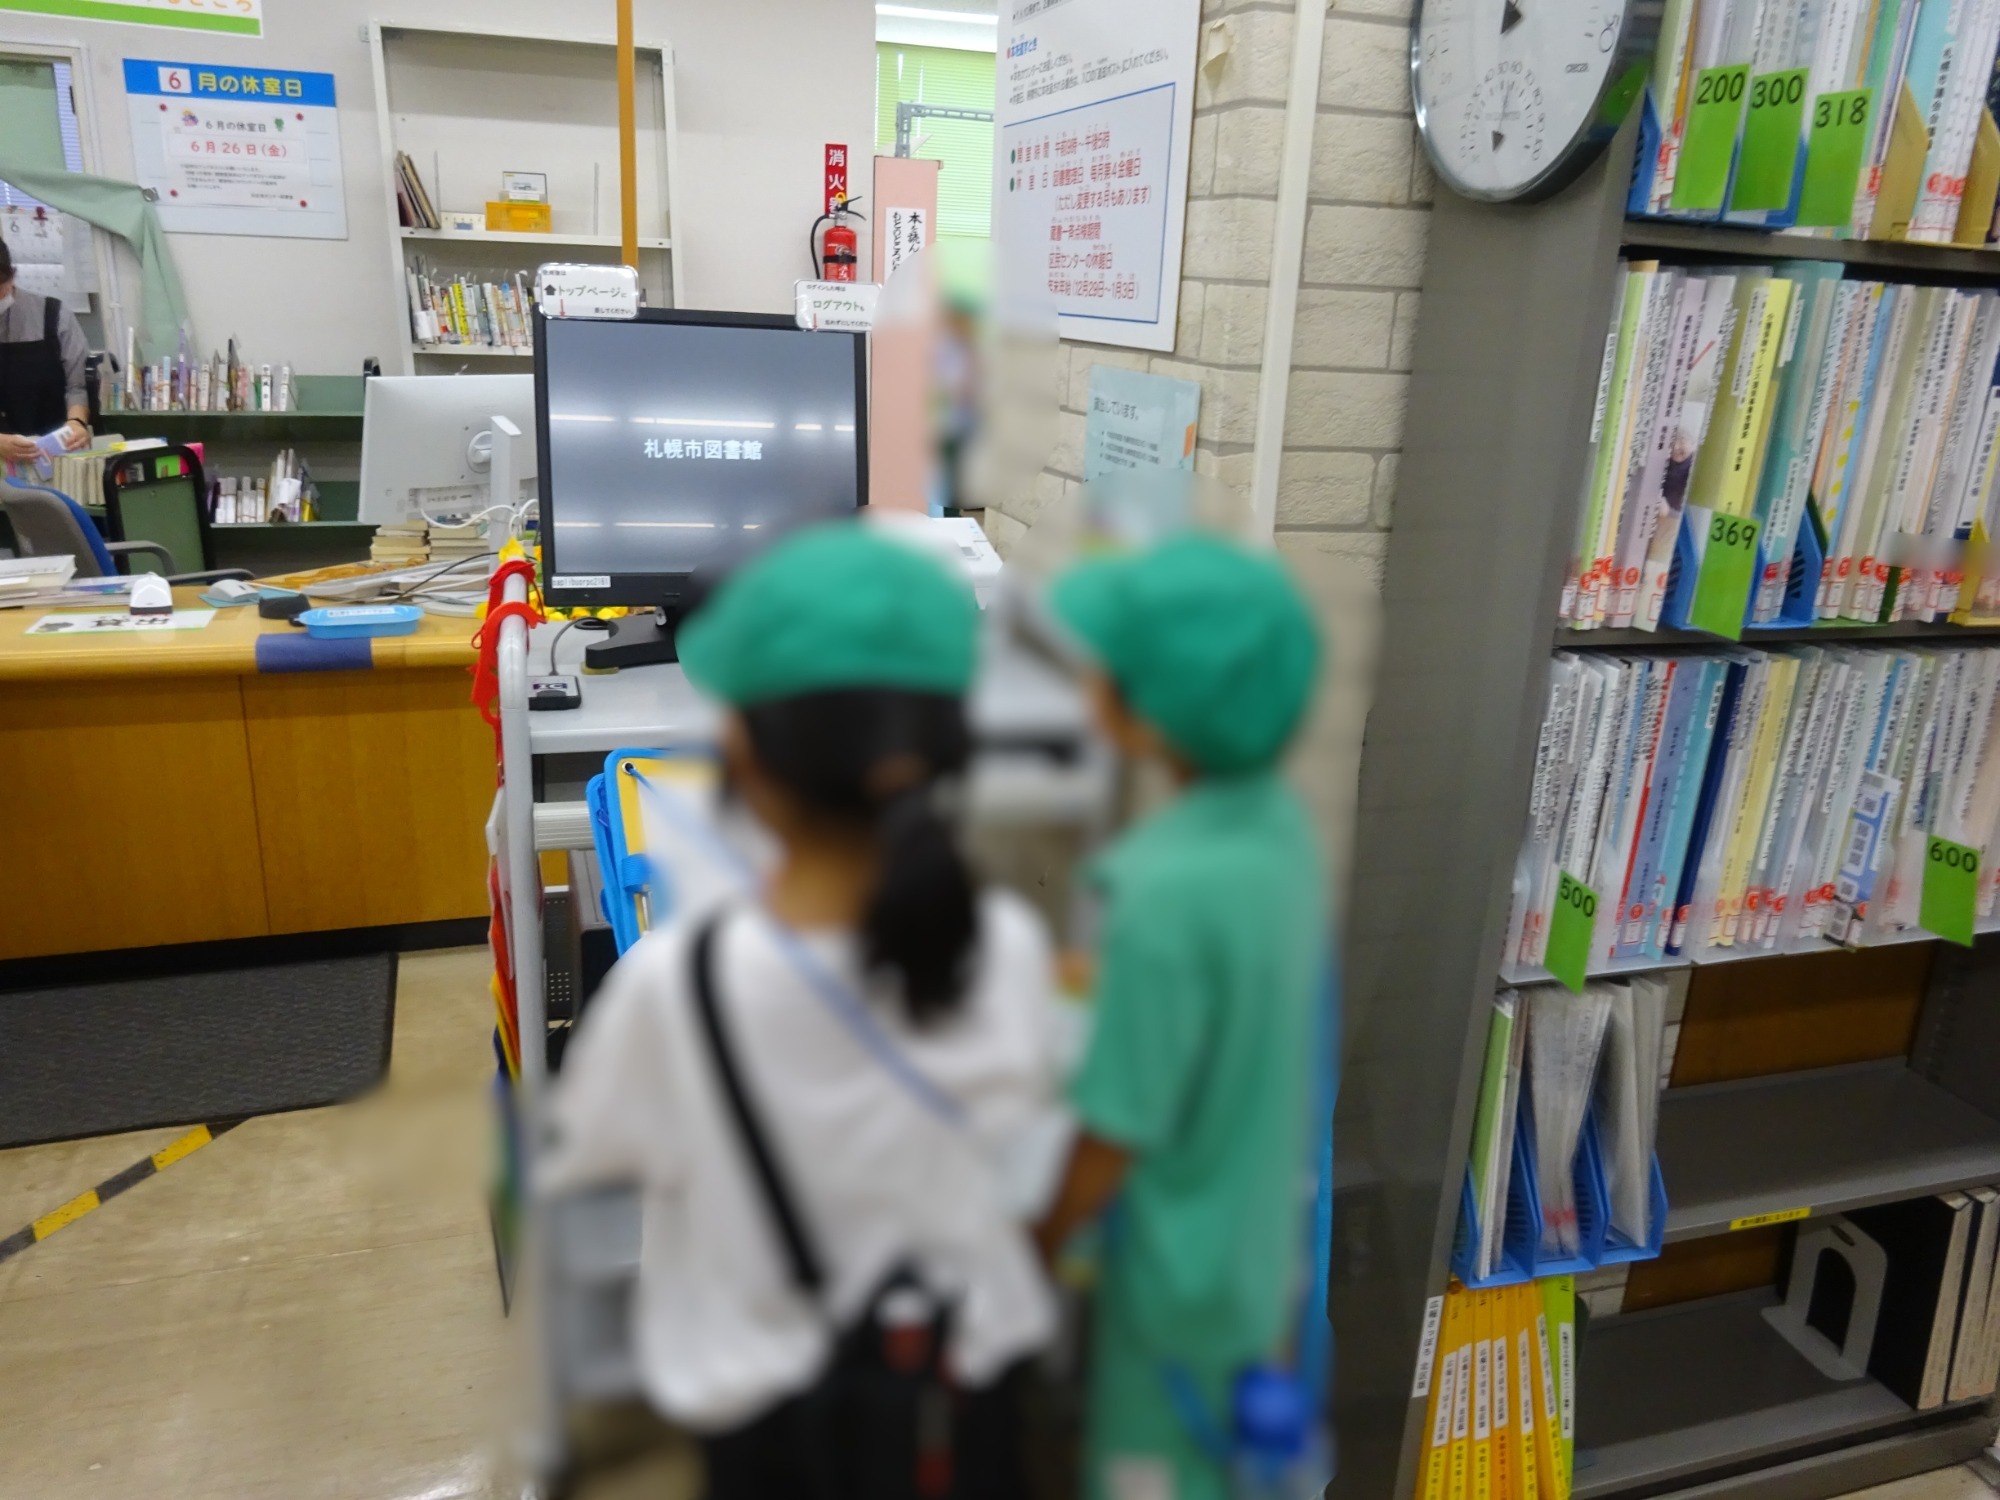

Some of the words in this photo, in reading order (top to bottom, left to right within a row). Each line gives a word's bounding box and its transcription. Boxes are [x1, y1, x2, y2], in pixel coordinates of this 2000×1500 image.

[168, 72, 182, 91] 6
[198, 73, 303, 98] 月の休室日
[1696, 72, 1745, 105] 200
[1752, 75, 1801, 110] 300
[1815, 97, 1867, 129] 318
[558, 284, 628, 298] トップページに
[813, 299, 865, 312] ログアウトも
[643, 438, 763, 461] 札幌市図書館
[1710, 517, 1757, 551] 369
[1929, 841, 1977, 873] 600
[1559, 876, 1595, 918] 500
